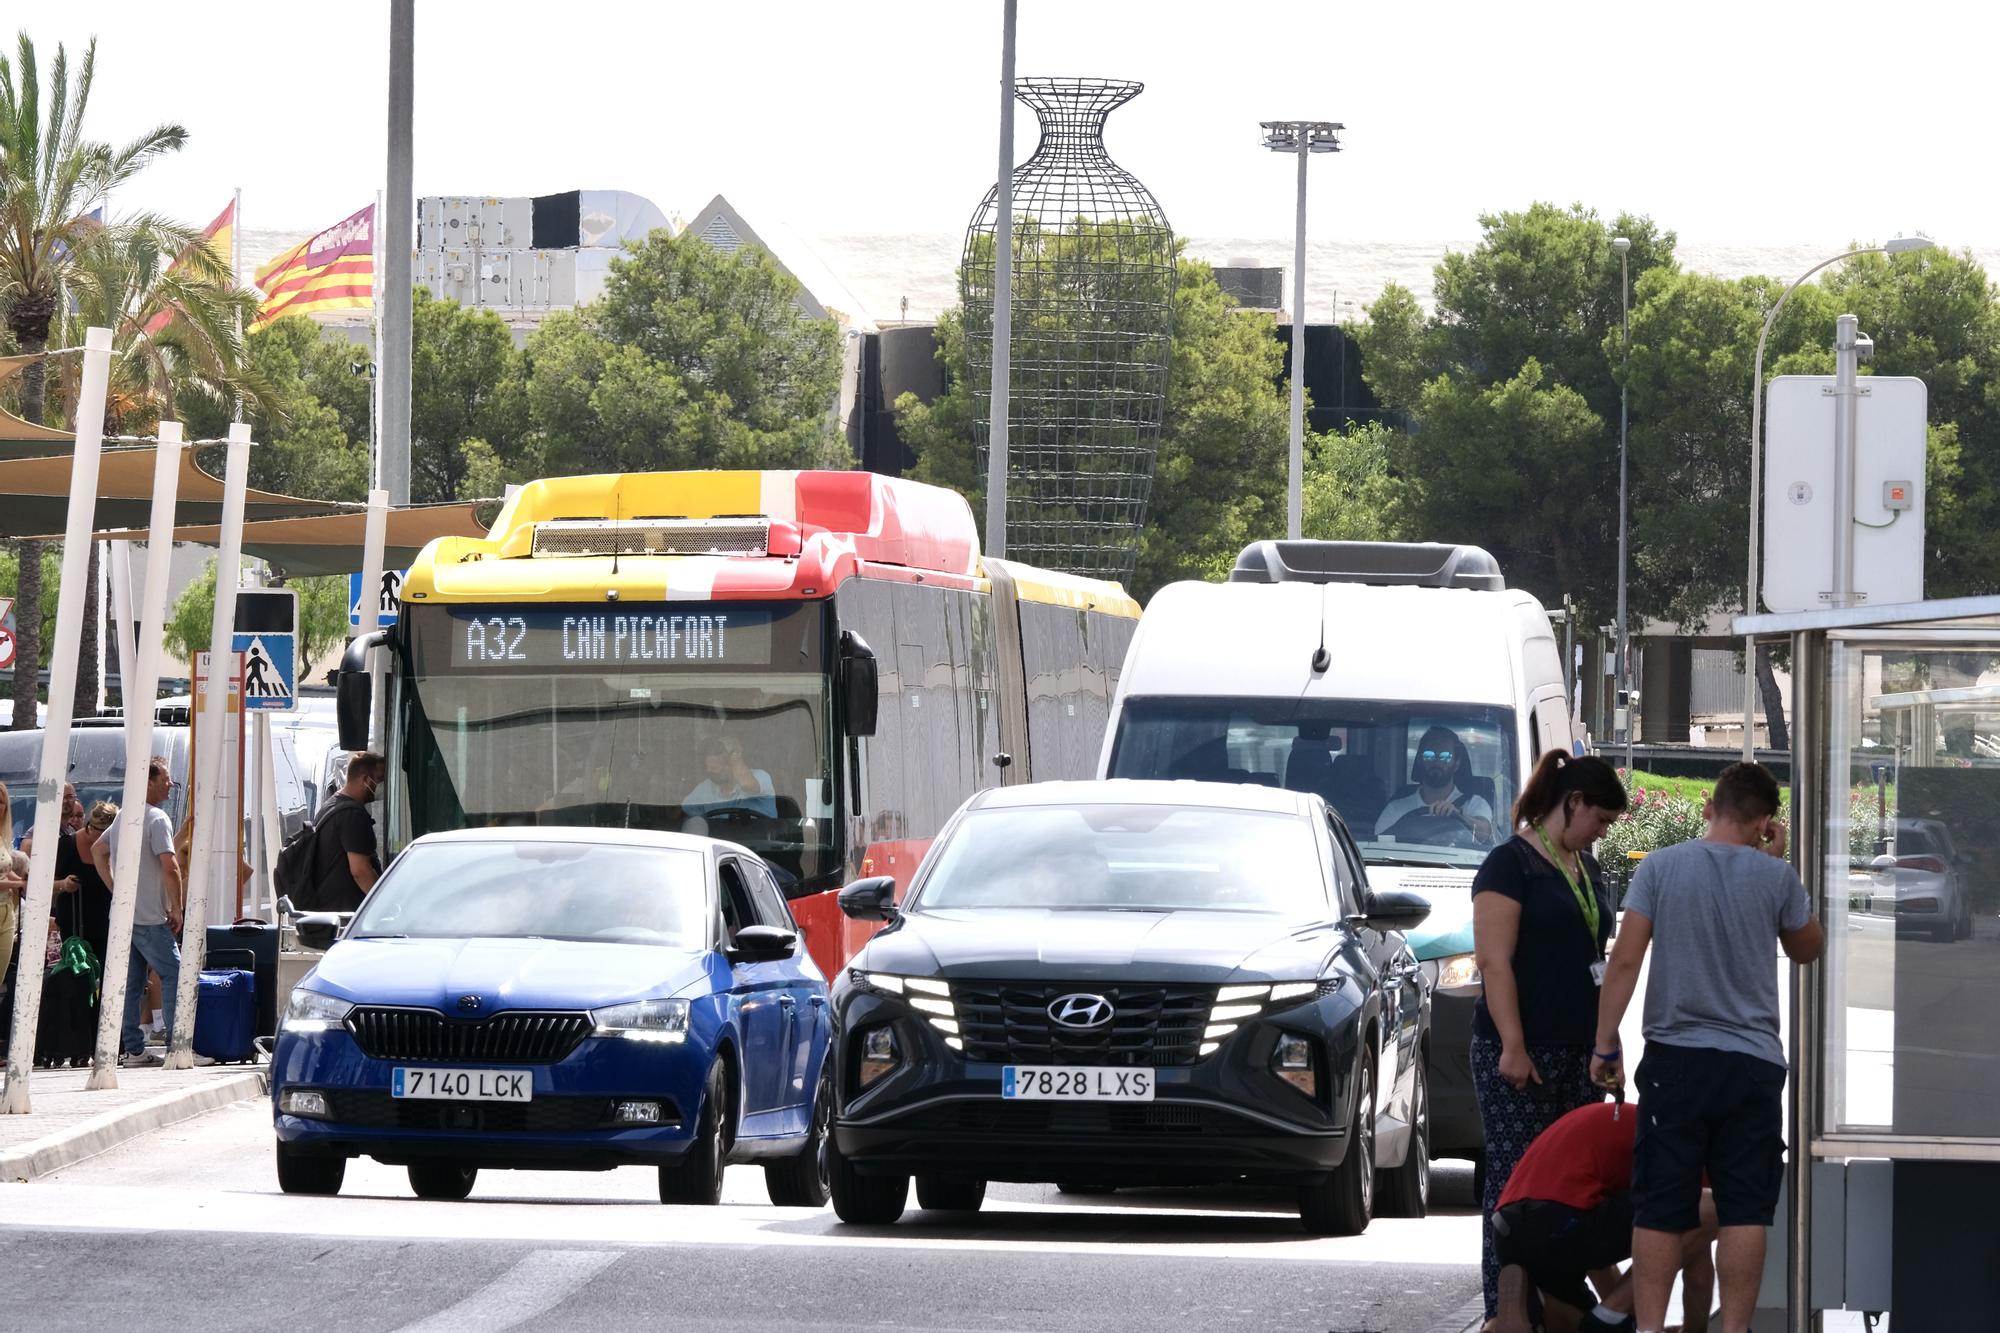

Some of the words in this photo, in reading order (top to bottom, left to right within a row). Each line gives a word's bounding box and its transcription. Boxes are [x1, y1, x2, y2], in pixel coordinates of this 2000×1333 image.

[467, 617, 527, 660] A32
[615, 615, 728, 659] PICAFORT
[410, 1071, 470, 1096] 7140
[479, 1073, 524, 1098] LCK
[1021, 1070, 1088, 1095] 7828
[1097, 1071, 1147, 1096] LXS
